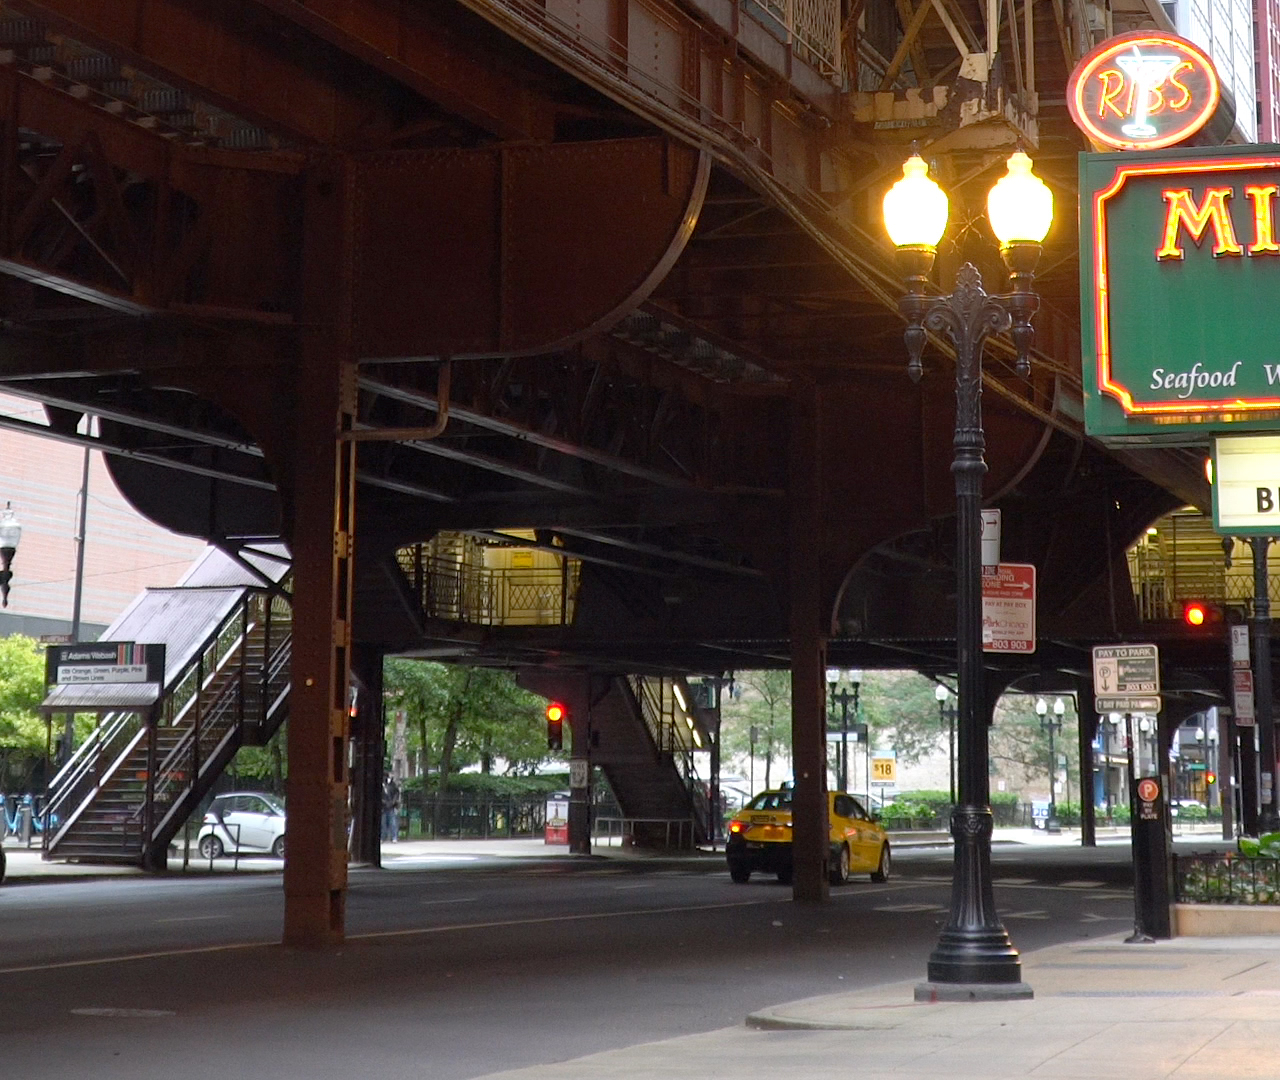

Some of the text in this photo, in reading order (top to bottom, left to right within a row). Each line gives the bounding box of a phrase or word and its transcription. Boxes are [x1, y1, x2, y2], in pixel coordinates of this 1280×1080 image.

[1099, 62, 1195, 119] RIBS
[1150, 361, 1243, 399] Seafood
[993, 640, 1027, 650] 803 903
[1098, 648, 1151, 658] PAY TO PARK
[874, 763, 892, 775] $18
